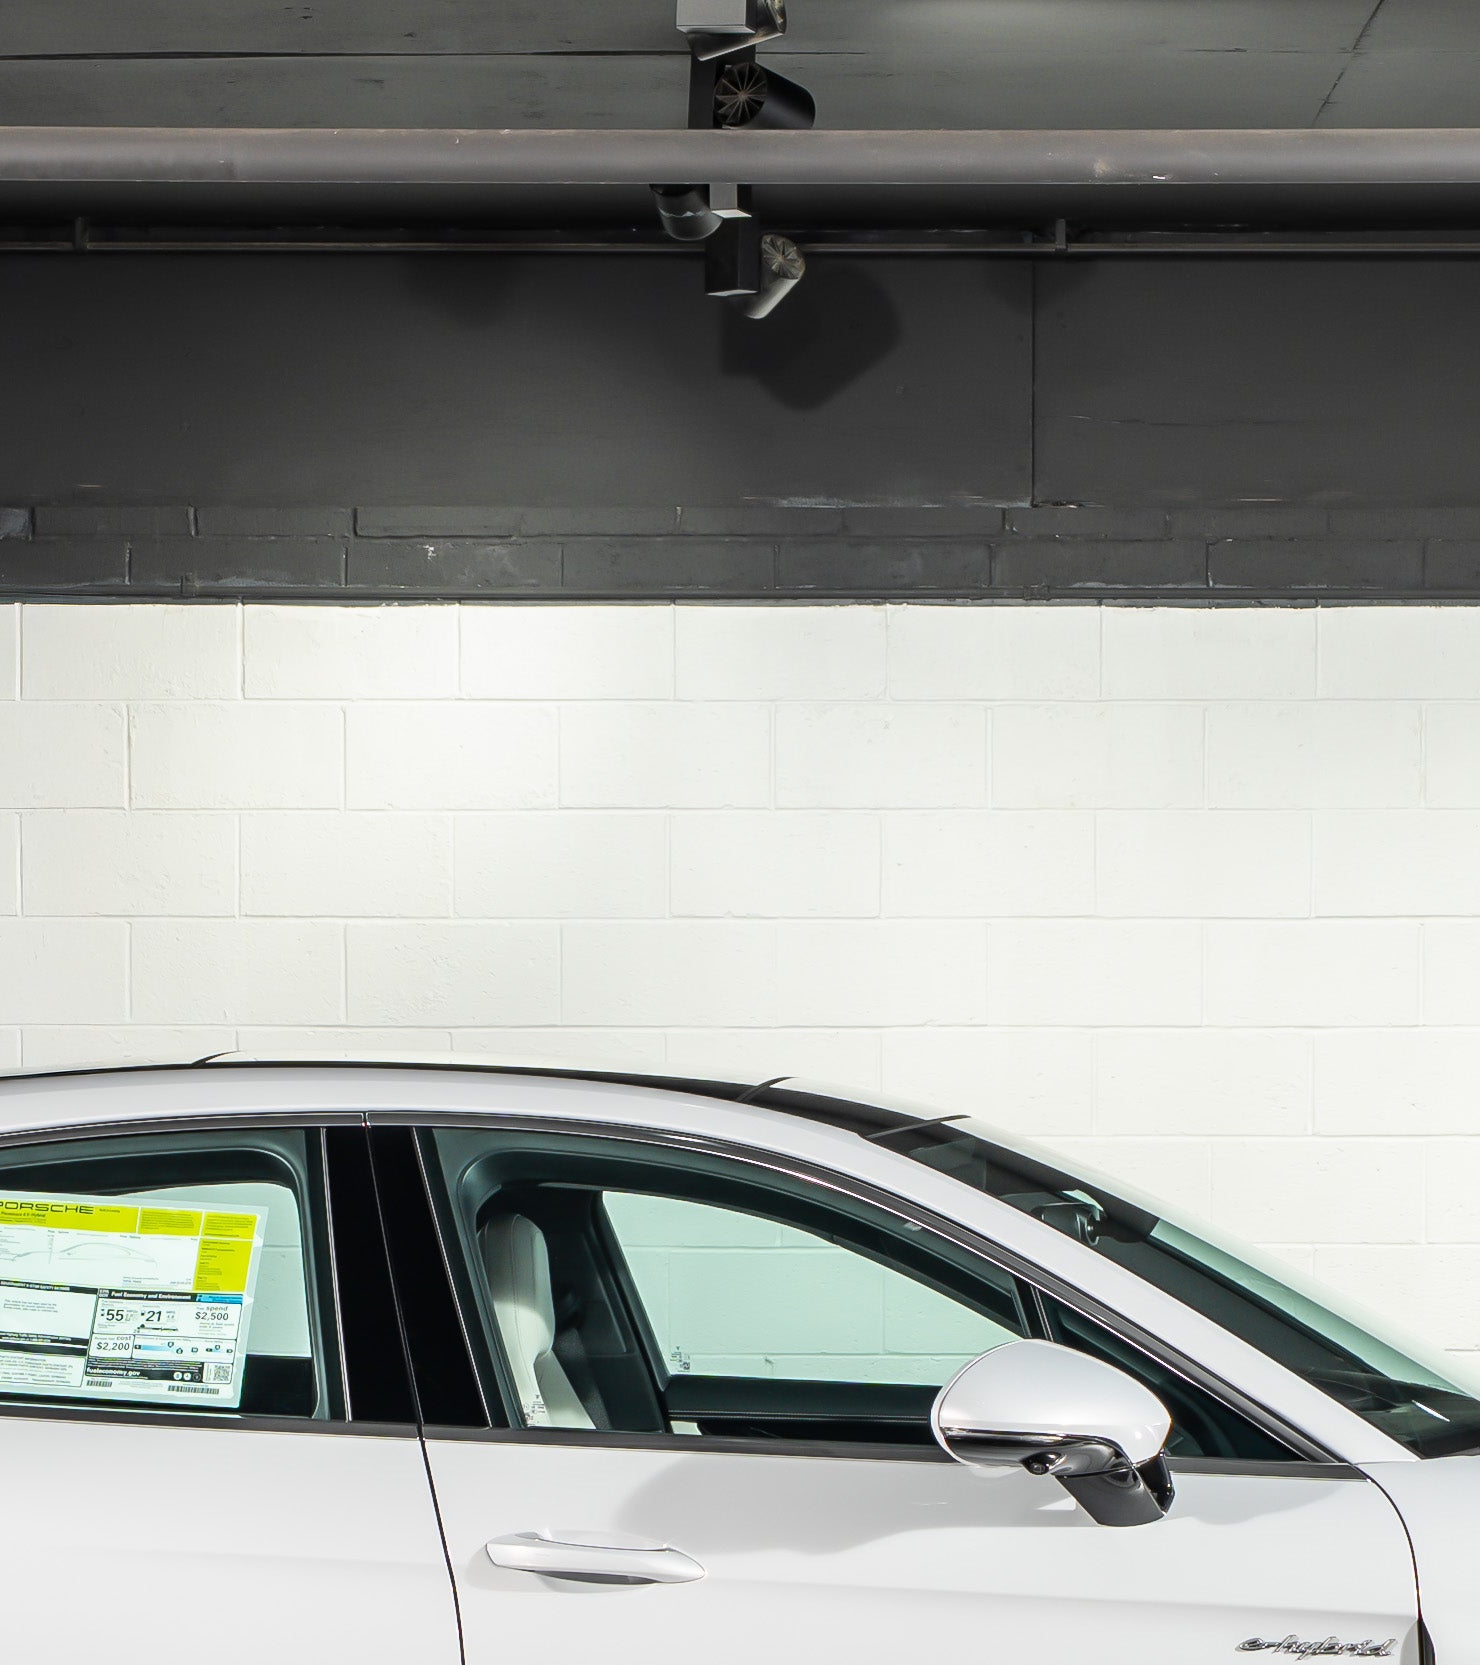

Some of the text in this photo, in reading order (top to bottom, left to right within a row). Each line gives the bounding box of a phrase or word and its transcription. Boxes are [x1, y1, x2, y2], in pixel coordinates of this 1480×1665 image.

[106, 1309, 125, 1321] 55
[146, 1310, 162, 1322] 21
[195, 1311, 229, 1321] $2,500
[96, 1341, 130, 1352] $2,200
[86, 1366, 141, 1377] fueleconomy.gov
